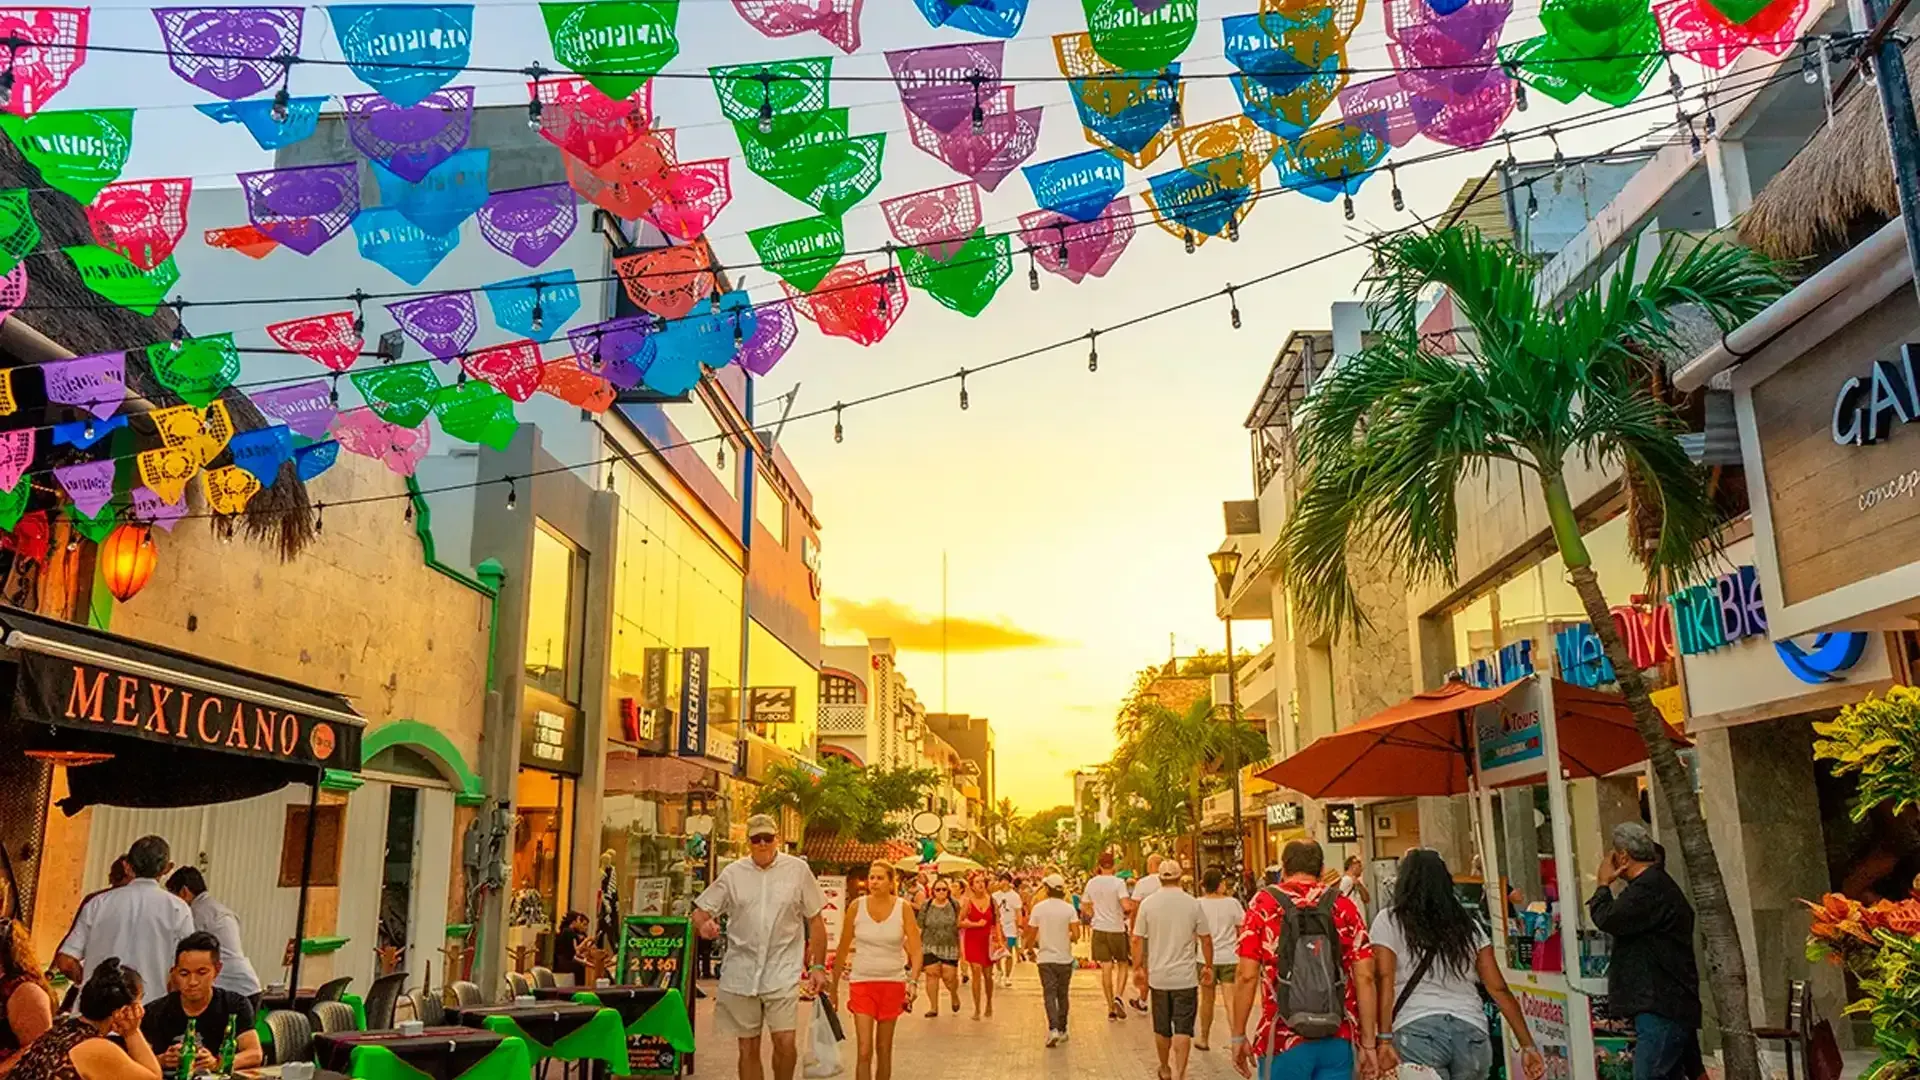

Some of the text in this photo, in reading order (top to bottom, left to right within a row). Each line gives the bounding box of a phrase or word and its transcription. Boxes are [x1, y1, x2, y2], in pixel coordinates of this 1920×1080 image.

[65, 666, 300, 756] MEXICANO
[686, 651, 701, 752] SKECHERS
[628, 937, 684, 949] CERVEZAS
[631, 957, 640, 971] 2
